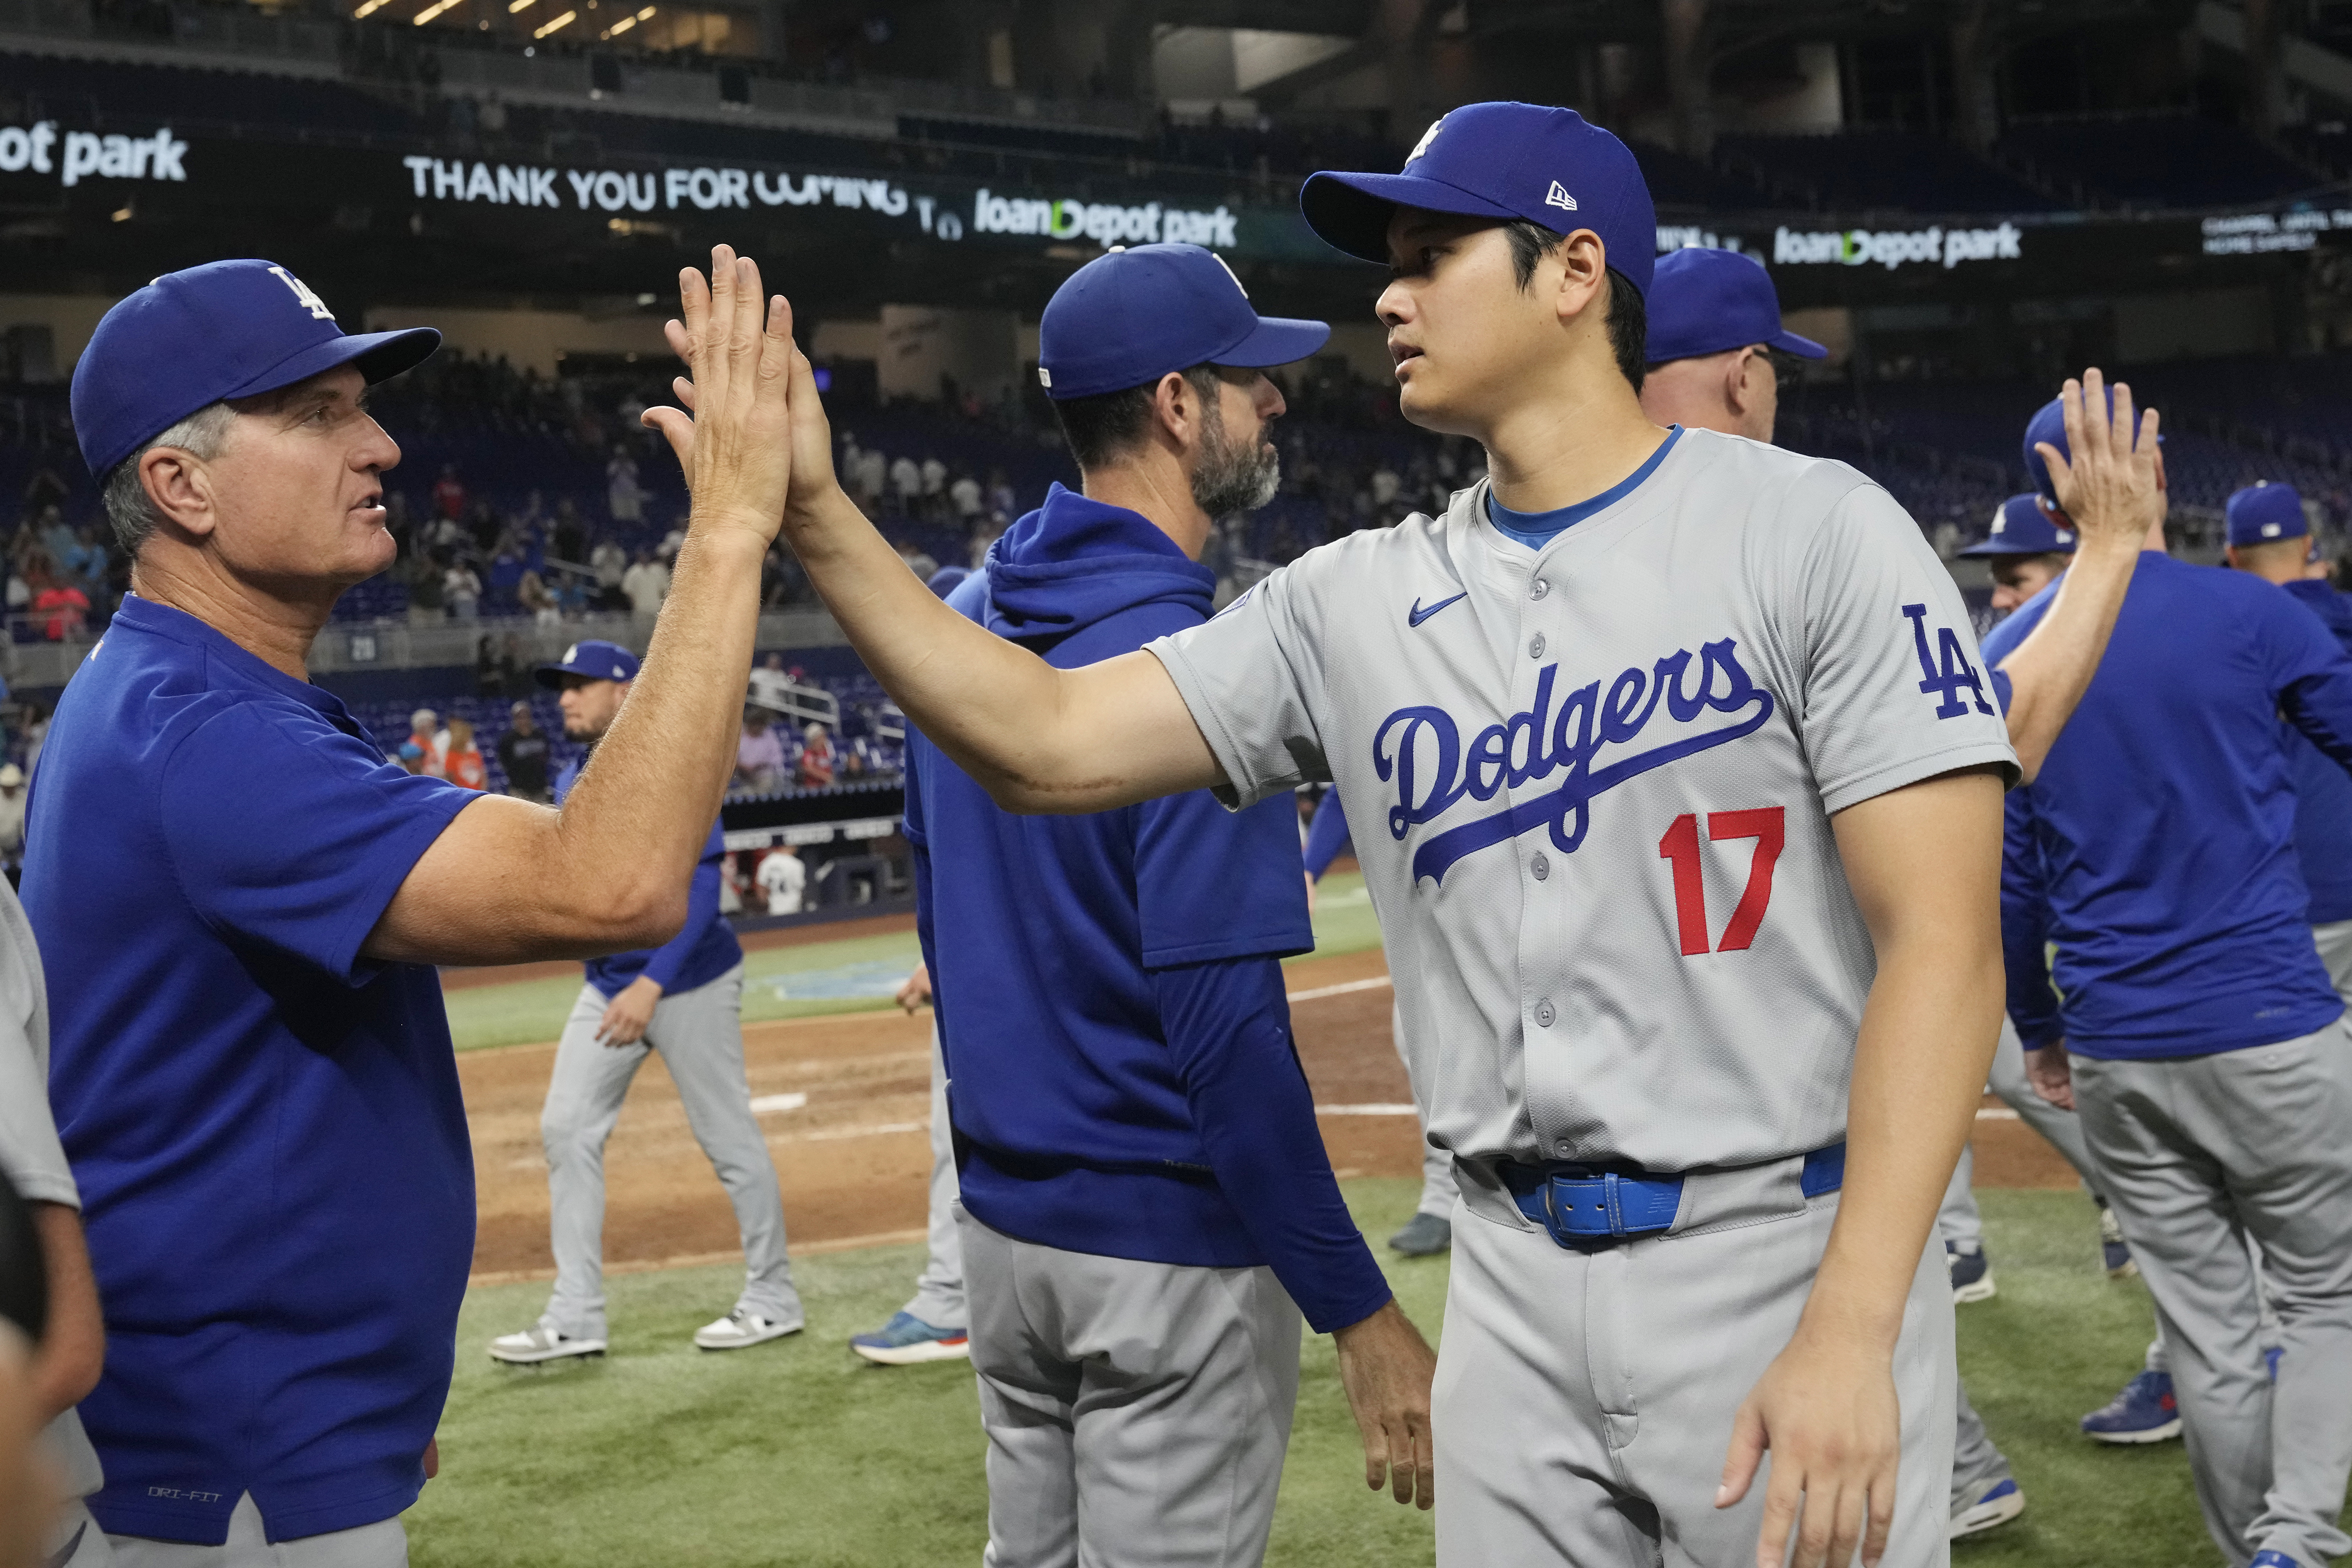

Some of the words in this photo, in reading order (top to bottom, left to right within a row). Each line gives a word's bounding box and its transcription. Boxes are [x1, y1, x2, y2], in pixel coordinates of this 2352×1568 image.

[62, 127, 190, 187] park
[404, 155, 560, 209] THANK
[566, 169, 656, 212] YOU
[664, 166, 750, 210] FOR
[974, 188, 1162, 246] loanDepot
[1163, 205, 1238, 246] park
[1774, 224, 1943, 270] loanDepot
[1943, 221, 2022, 269] park
[1901, 603, 1995, 720] LA
[1373, 637, 1774, 854] Dodgers
[1659, 806, 1785, 956] 17
[148, 1486, 223, 1503] DRI-FIT
